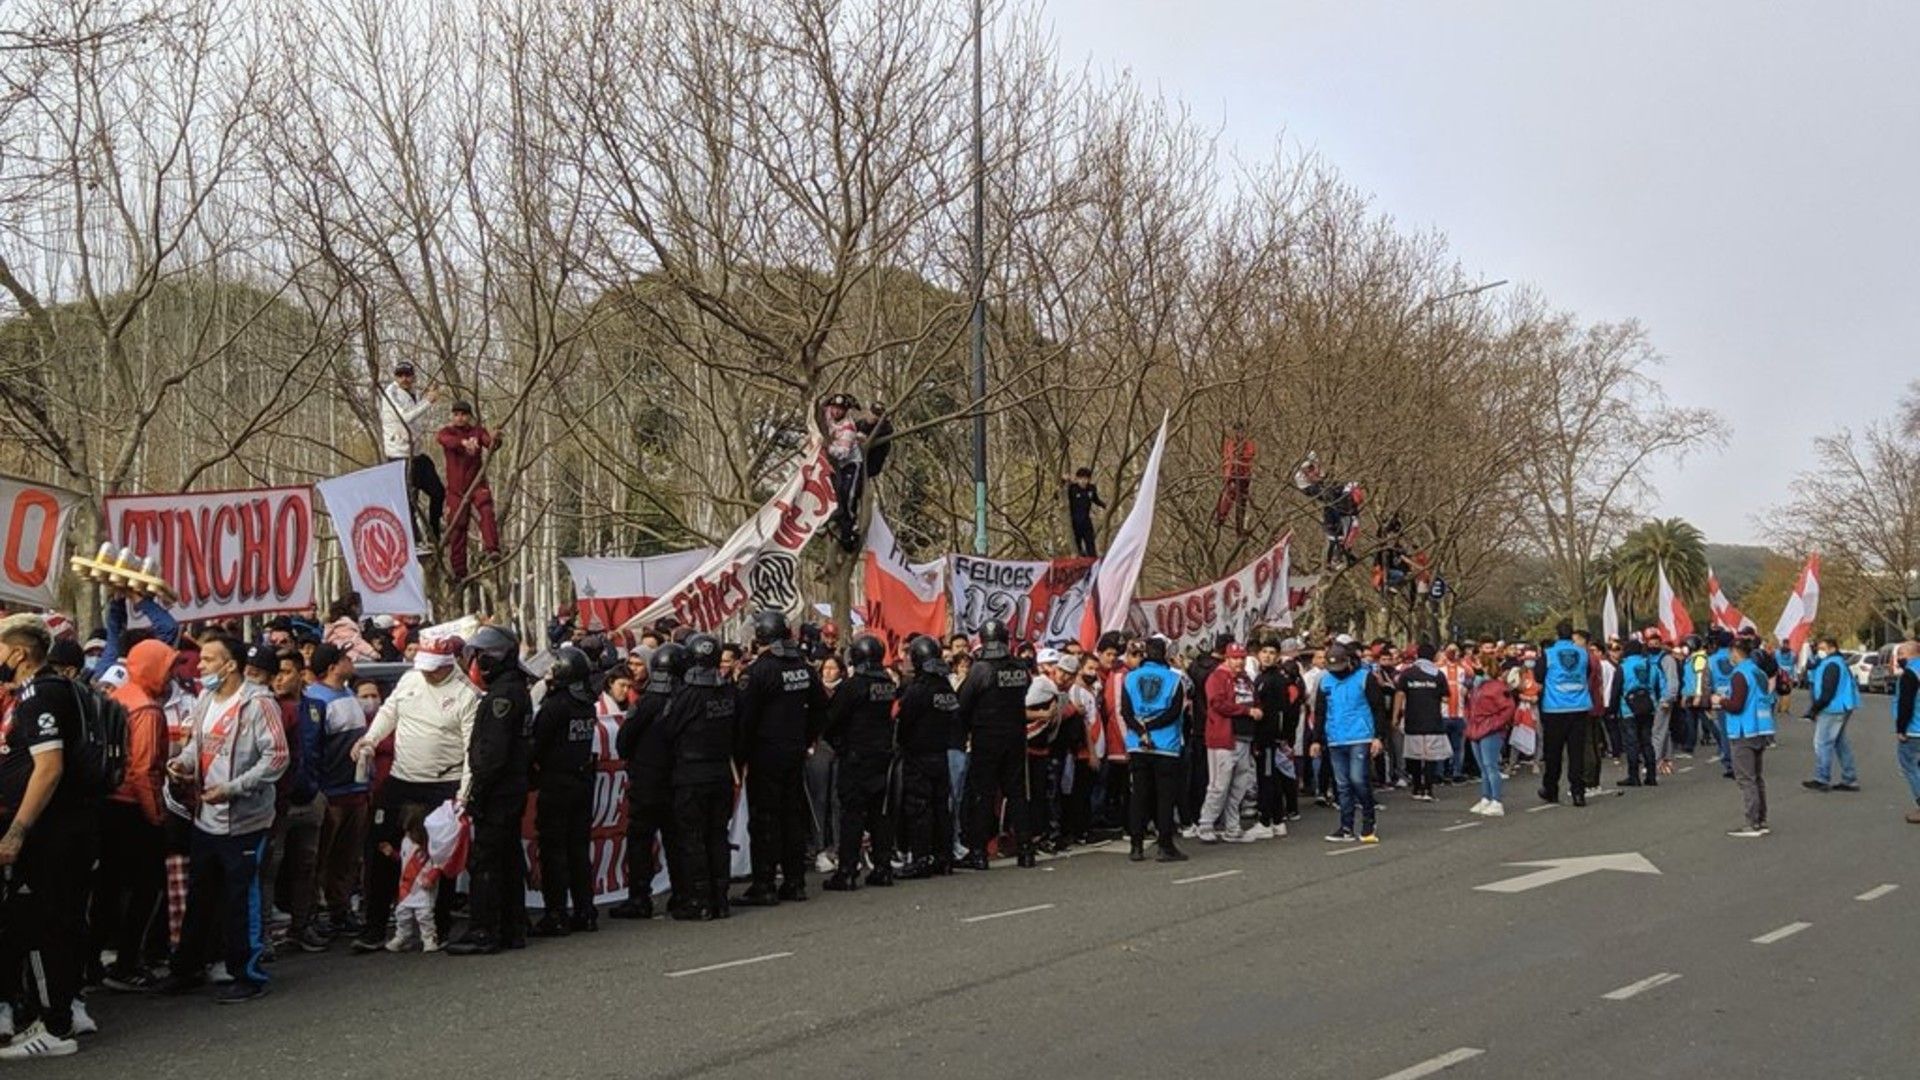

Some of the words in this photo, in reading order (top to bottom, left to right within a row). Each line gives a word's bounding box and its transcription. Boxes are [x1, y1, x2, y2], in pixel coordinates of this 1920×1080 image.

[121, 494, 309, 608] TINCHO
[955, 557, 1034, 588] FELICES
[782, 668, 810, 682] POLICIA
[998, 669, 1027, 681] POLICIA
